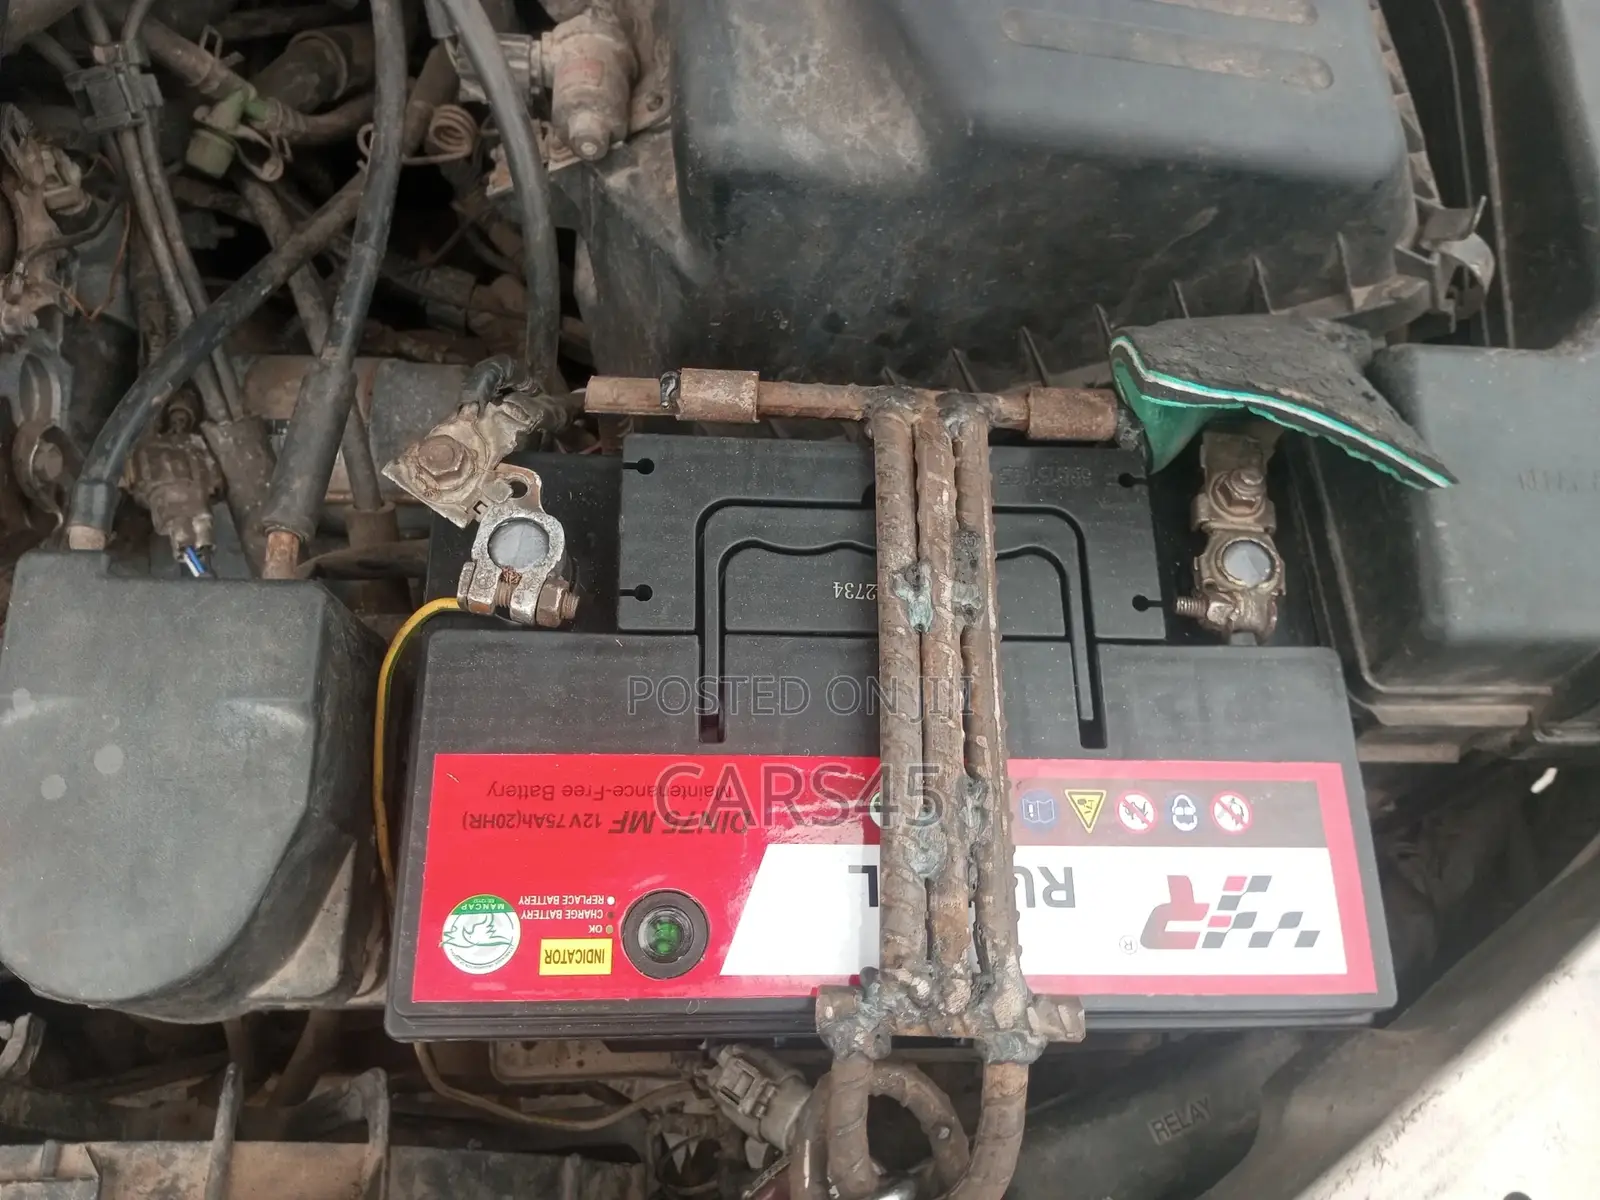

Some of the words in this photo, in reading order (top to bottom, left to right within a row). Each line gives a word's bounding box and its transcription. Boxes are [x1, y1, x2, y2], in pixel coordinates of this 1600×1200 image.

[487, 783, 555, 800] Battery
[561, 784, 733, 801] Maintenance-Free
[462, 811, 566, 831] 75Ah(20HR)
[570, 814, 602, 830] 12V
[608, 810, 657, 835] MF
[661, 810, 752, 835] DIN75
[460, 902, 505, 912] MANCAP
[518, 894, 560, 906] BATTERY
[563, 894, 605, 906] REPLACE
[520, 909, 563, 920] BATTERY
[564, 909, 604, 921] CHARGE
[587, 923, 604, 935] OK
[543, 948, 606, 965] INDICATOR
[1151, 1096, 1214, 1142] RELAY
